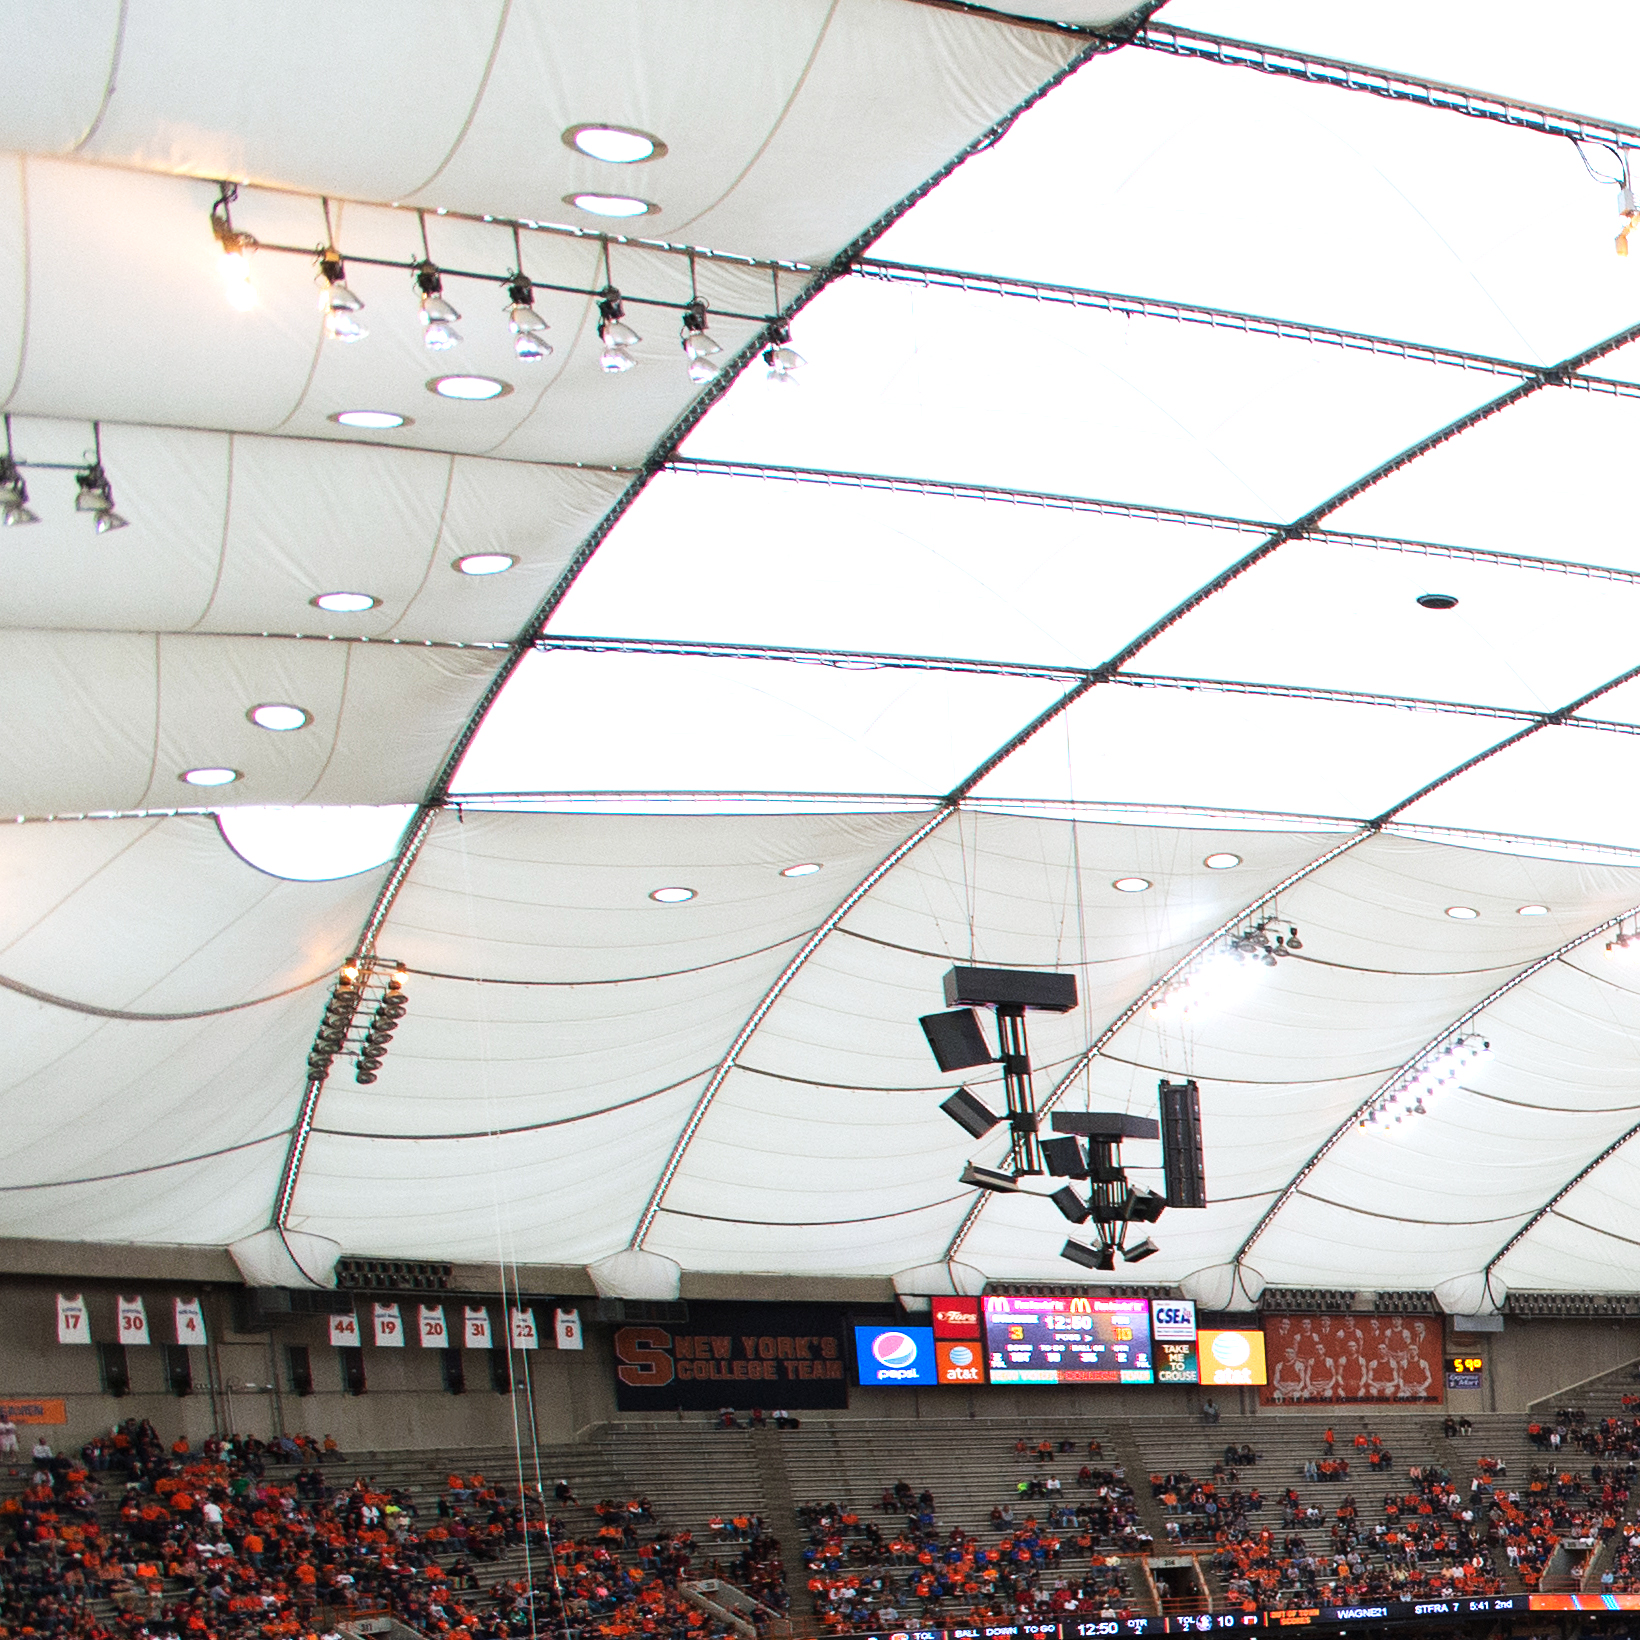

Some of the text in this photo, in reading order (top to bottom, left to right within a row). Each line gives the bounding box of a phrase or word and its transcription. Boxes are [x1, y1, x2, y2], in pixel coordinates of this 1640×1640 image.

[64, 1314, 81, 1330] 17
[1044, 1315, 1092, 1330] 12:50
[1156, 1308, 1191, 1324] CSEA
[122, 1316, 144, 1331] 30
[185, 1317, 196, 1332] 4
[334, 1321, 356, 1334] 44
[380, 1321, 396, 1335] 19
[424, 1322, 443, 1336] 20
[471, 1323, 485, 1337] 31
[564, 1324, 574, 1338] 8
[1008, 1325, 1024, 1340] 3
[674, 1336, 838, 1359] NEW YORK'S
[1162, 1344, 1190, 1354] TAKE
[614, 1326, 674, 1386] S
[1169, 1354, 1184, 1362] ME
[676, 1360, 844, 1380] COLLEGE TEAM
[1170, 1362, 1185, 1370] TO
[946, 1367, 978, 1380] at&t
[1158, 1371, 1196, 1380] CROUSE
[1337, 1608, 1388, 1620] WAGNE21
[1414, 1600, 1513, 1614] STFRA 7 5:41 2nd
[1177, 1616, 1196, 1625] TOL
[1218, 1615, 1235, 1628] 10
[954, 1624, 1056, 1638] BALL DOWN TO GO
[1077, 1622, 1119, 1636] 12:50
[1134, 1626, 1144, 1636] 2
[1182, 1624, 1190, 1632] 2
[914, 1632, 935, 1640] TOL
